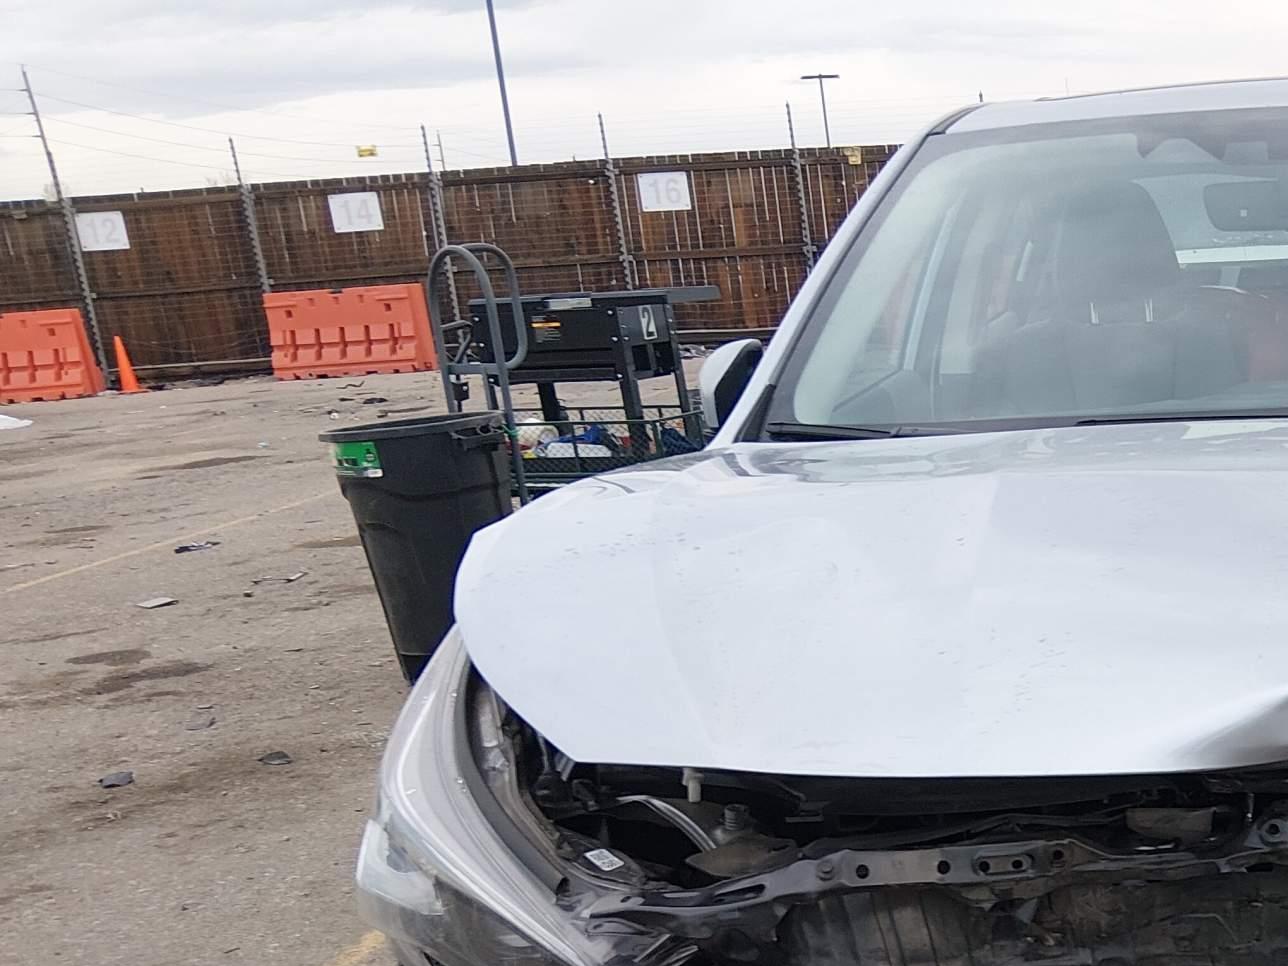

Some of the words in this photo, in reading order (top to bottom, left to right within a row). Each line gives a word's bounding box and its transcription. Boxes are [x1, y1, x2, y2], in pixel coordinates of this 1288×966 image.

[648, 178, 682, 204] 16
[339, 199, 373, 225] 14
[85, 218, 119, 243] 12
[641, 307, 655, 338] 2
